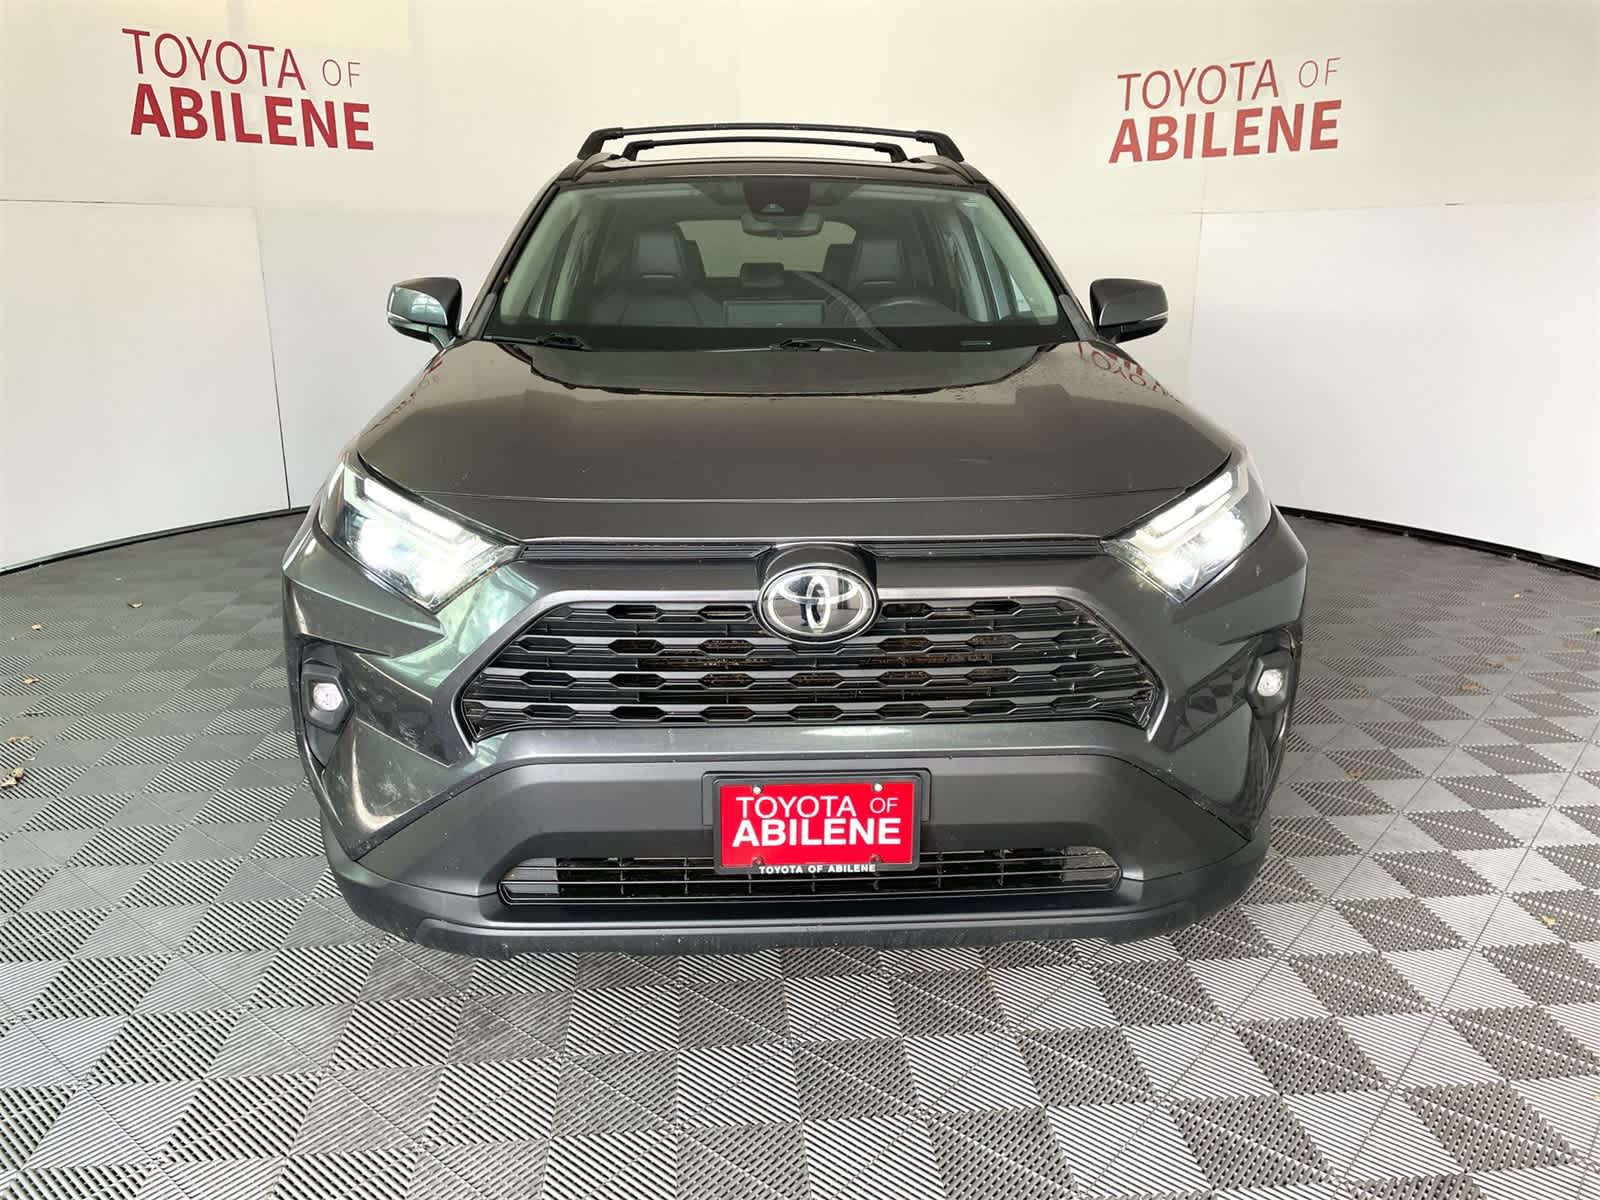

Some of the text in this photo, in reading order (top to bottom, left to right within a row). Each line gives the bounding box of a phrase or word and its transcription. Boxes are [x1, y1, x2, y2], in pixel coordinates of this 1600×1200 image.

[122, 28, 360, 90] TOYOTA OF
[1117, 57, 1341, 111] TOYOTA OF
[131, 83, 374, 150] ABILENE
[1109, 100, 1342, 163] ABILENE
[732, 817, 901, 847] ABILENE
[736, 795, 899, 819] TOYOTA OF
[758, 862, 877, 875] TOYOTA OF ABILENE
